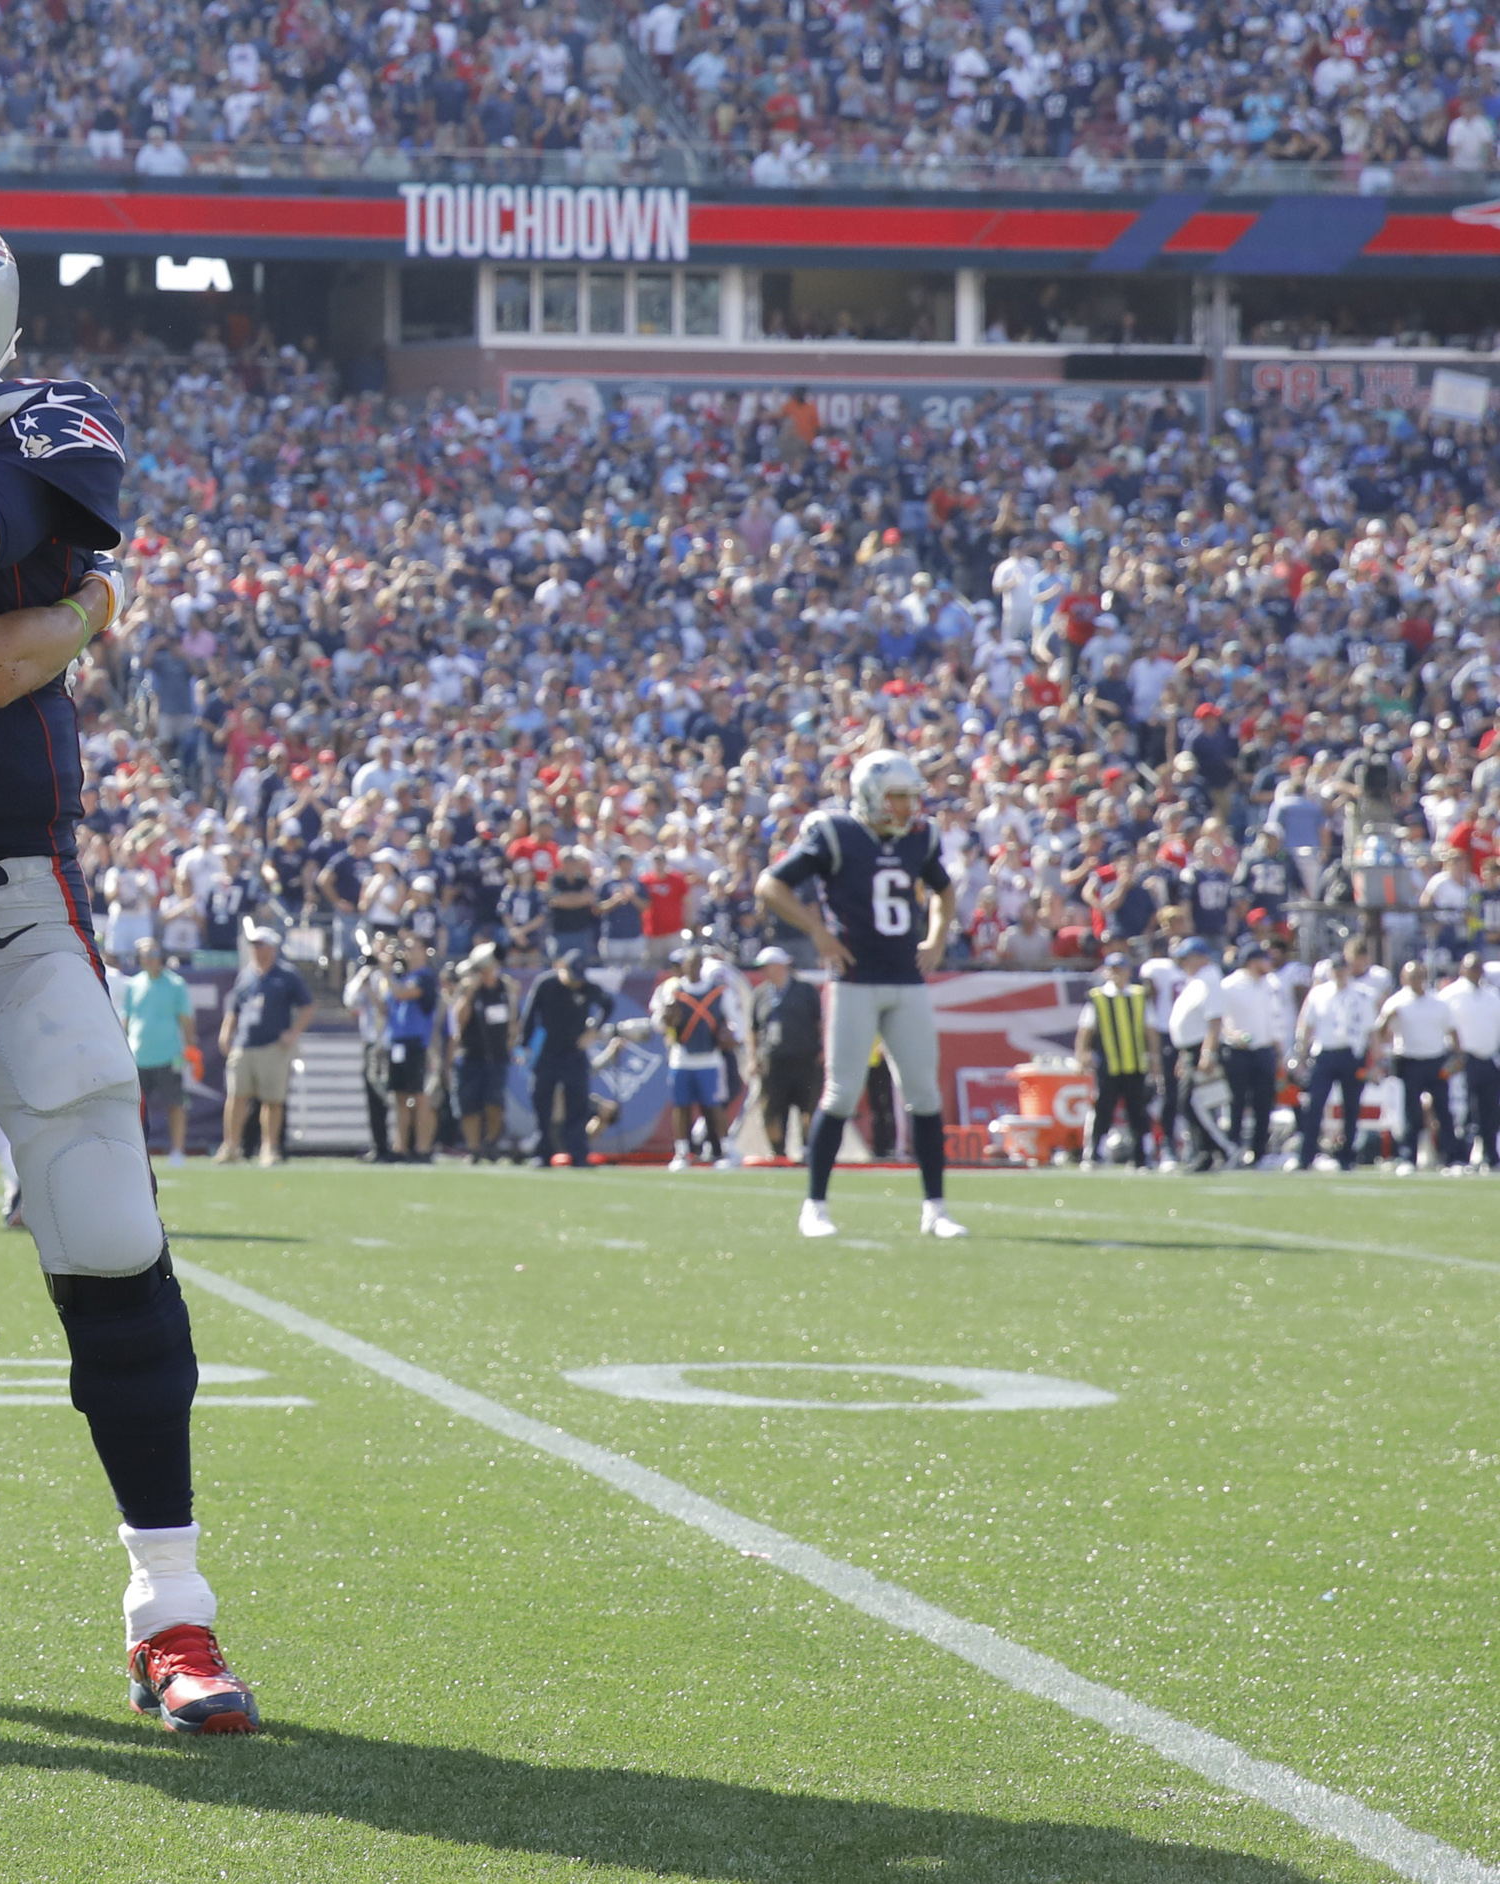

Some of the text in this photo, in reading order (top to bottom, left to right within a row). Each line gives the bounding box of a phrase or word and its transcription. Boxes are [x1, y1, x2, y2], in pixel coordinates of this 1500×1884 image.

[397, 182, 690, 262] TOUCHDOWN
[872, 868, 912, 937] 6
[1052, 1083, 1095, 1128] G
